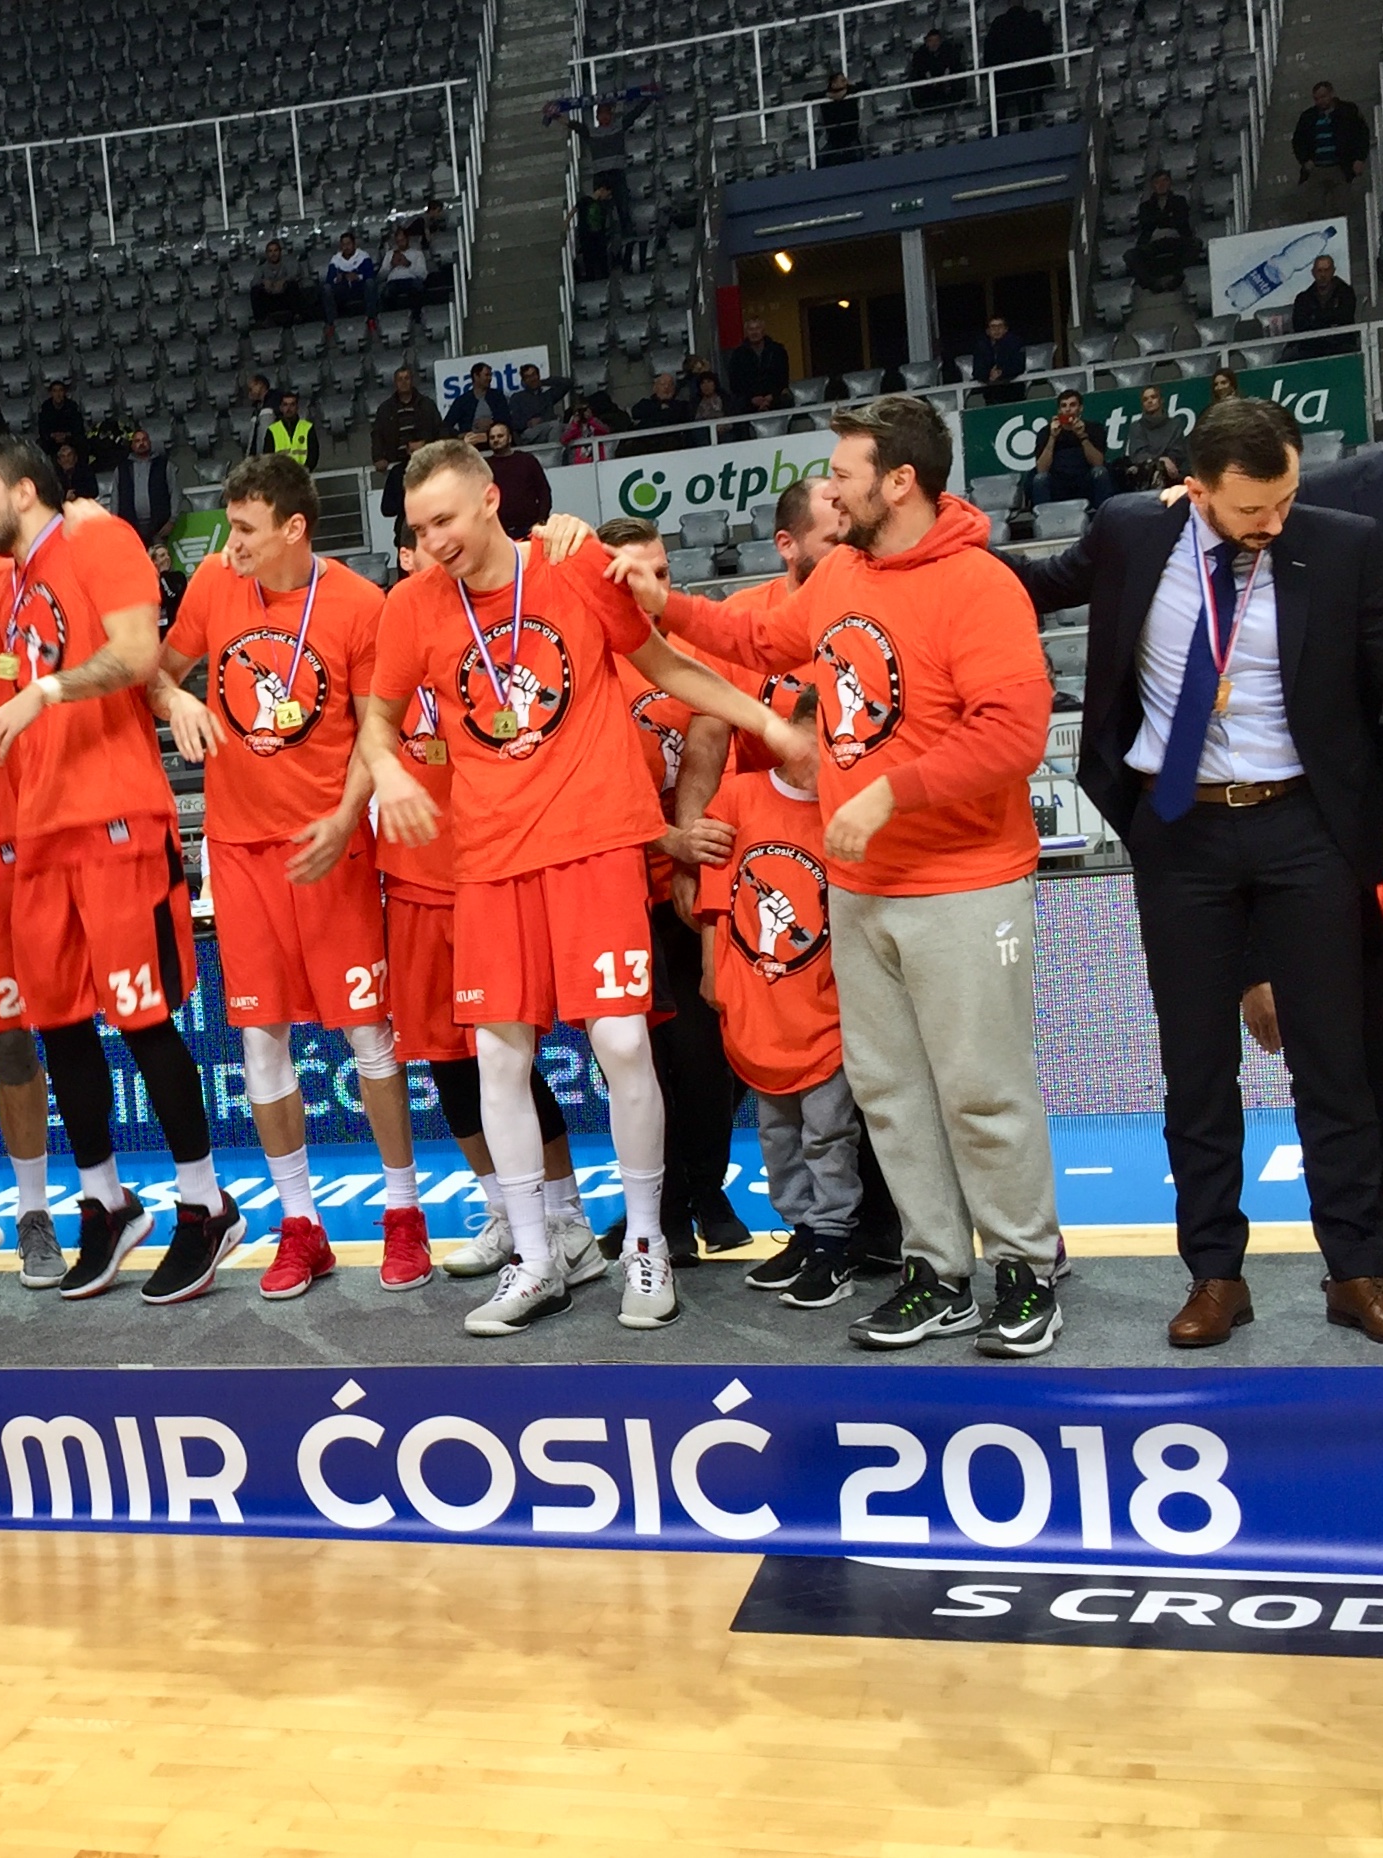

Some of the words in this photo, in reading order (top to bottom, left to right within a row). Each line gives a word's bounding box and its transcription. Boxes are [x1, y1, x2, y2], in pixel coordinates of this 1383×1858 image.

[766, 845, 796, 858] Ćosić
[795, 852, 815, 870] kup
[592, 949, 650, 1000] 13
[995, 936, 1020, 967] TC
[107, 962, 162, 1018] 31
[345, 958, 389, 1011] 27
[296, 1377, 782, 1541] ĆOSIĆ
[835, 1421, 1243, 1557] 2018
[930, 1583, 1024, 1618] S
